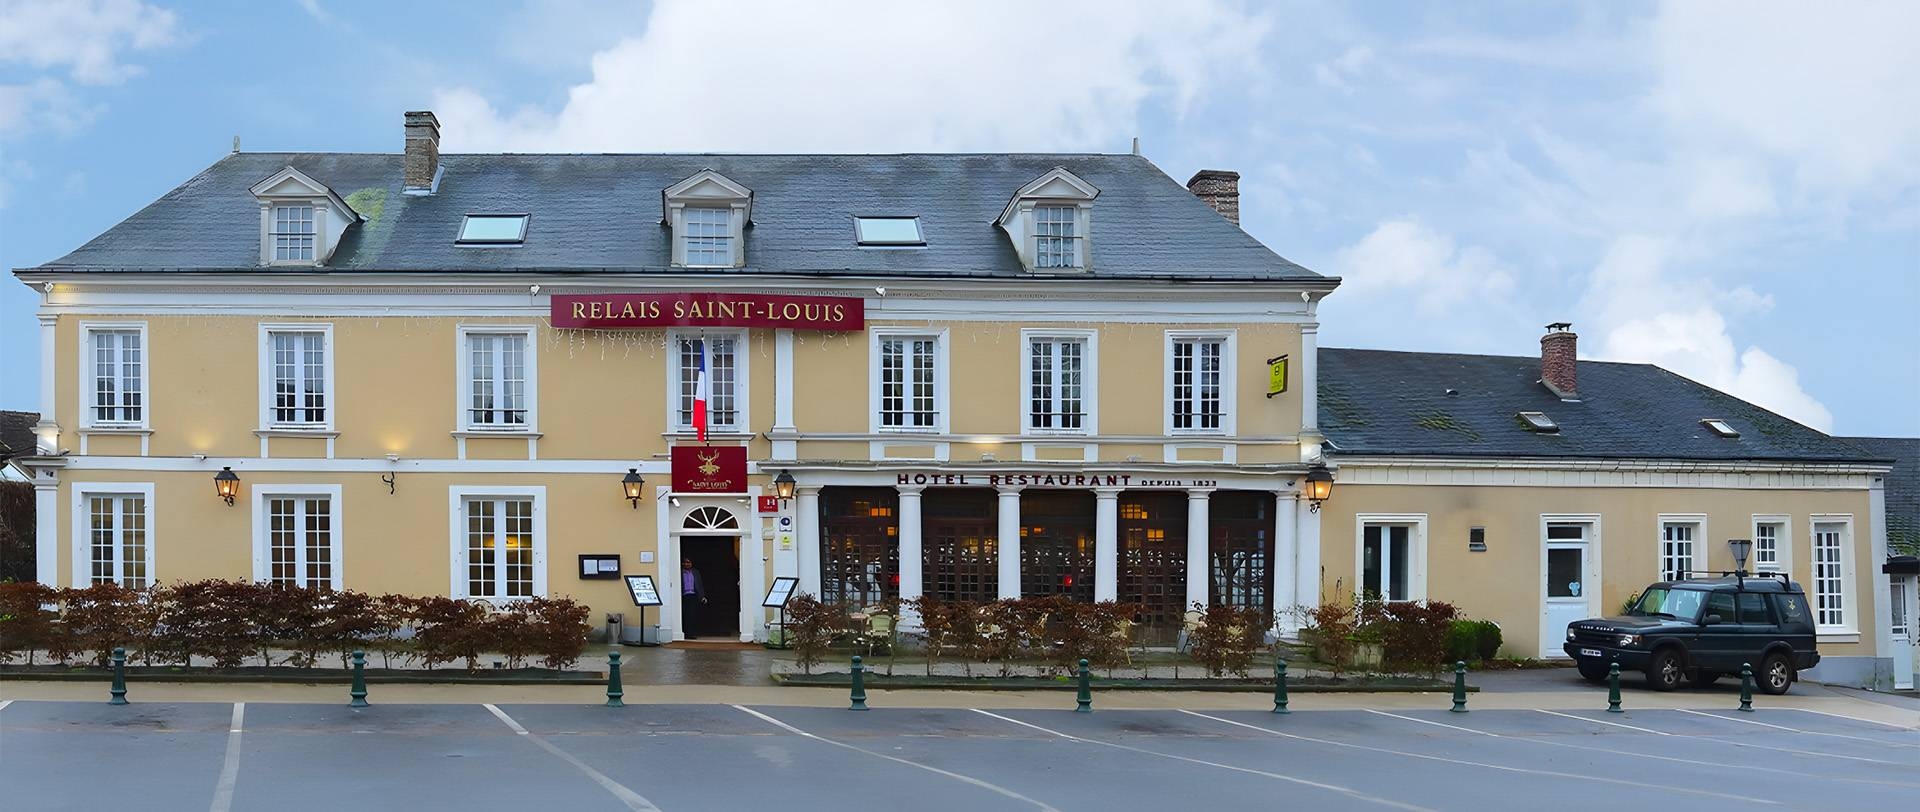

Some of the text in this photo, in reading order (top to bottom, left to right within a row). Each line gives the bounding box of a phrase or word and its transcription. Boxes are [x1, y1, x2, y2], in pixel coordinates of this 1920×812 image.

[571, 300, 844, 322] RELAIS SAINT-LOUIS
[897, 473, 969, 485] HOTEL
[989, 474, 1131, 486] RESTAURANT
[1141, 479, 1182, 487] DEPUIS
